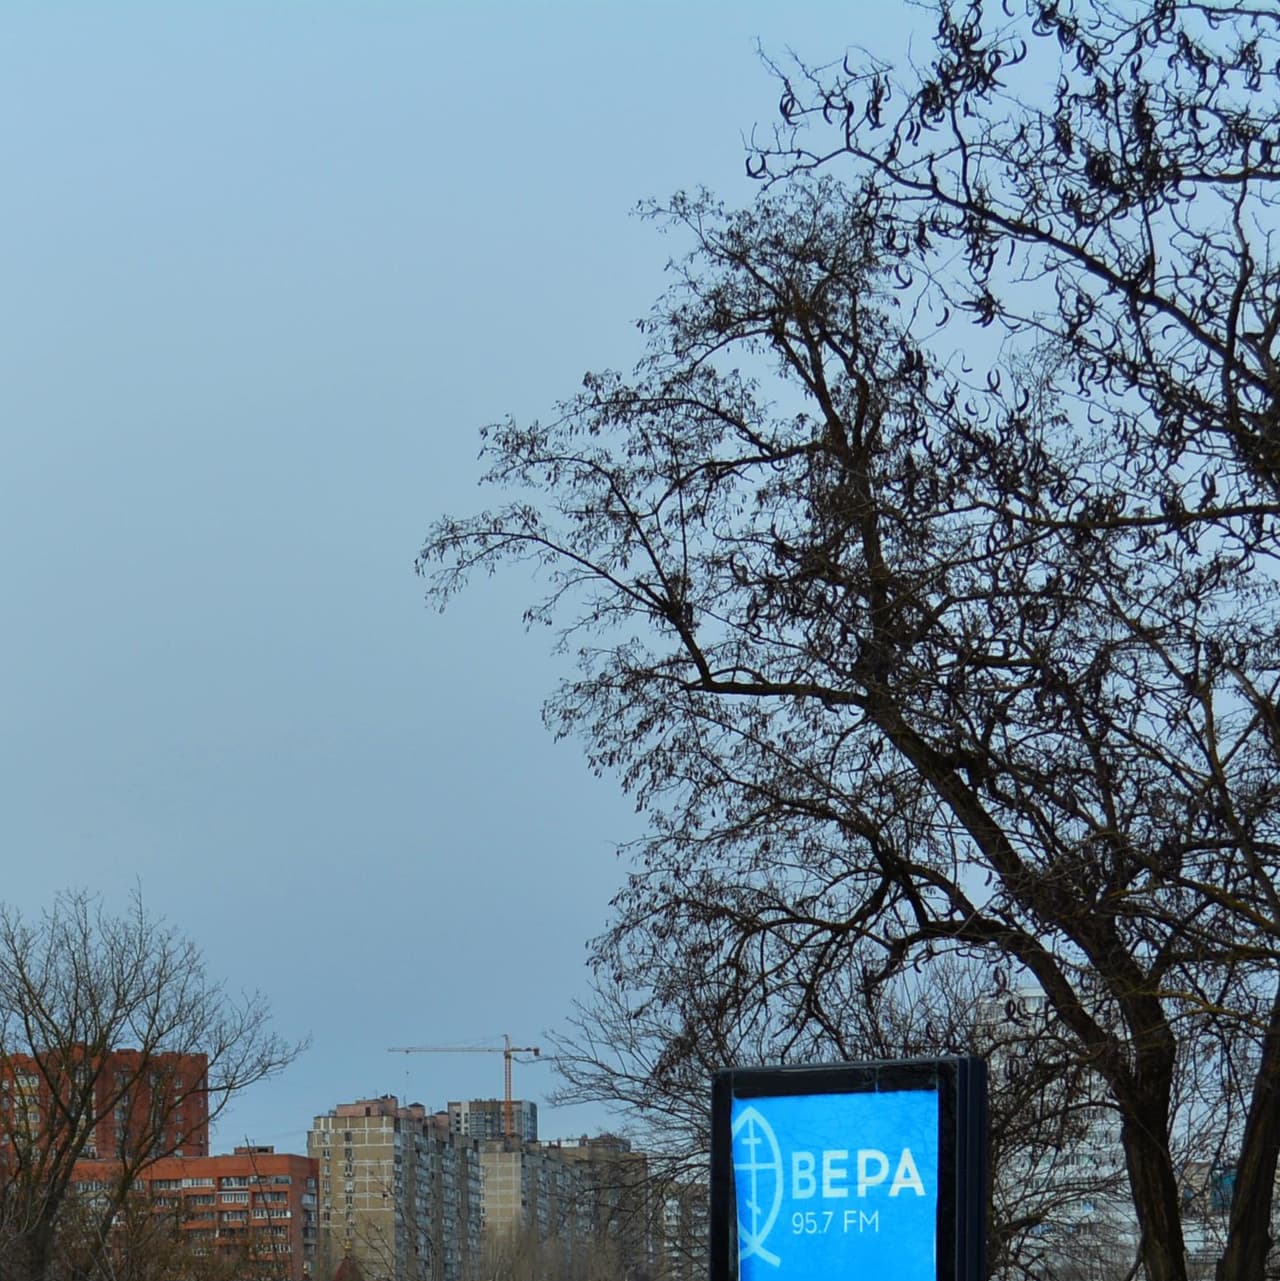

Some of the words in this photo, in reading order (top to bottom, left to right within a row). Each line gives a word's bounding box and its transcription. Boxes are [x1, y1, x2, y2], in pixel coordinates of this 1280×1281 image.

[792, 1148, 926, 1199] ВЕРА
[792, 1211, 834, 1235] 95.7
[843, 1209, 880, 1233] FM
